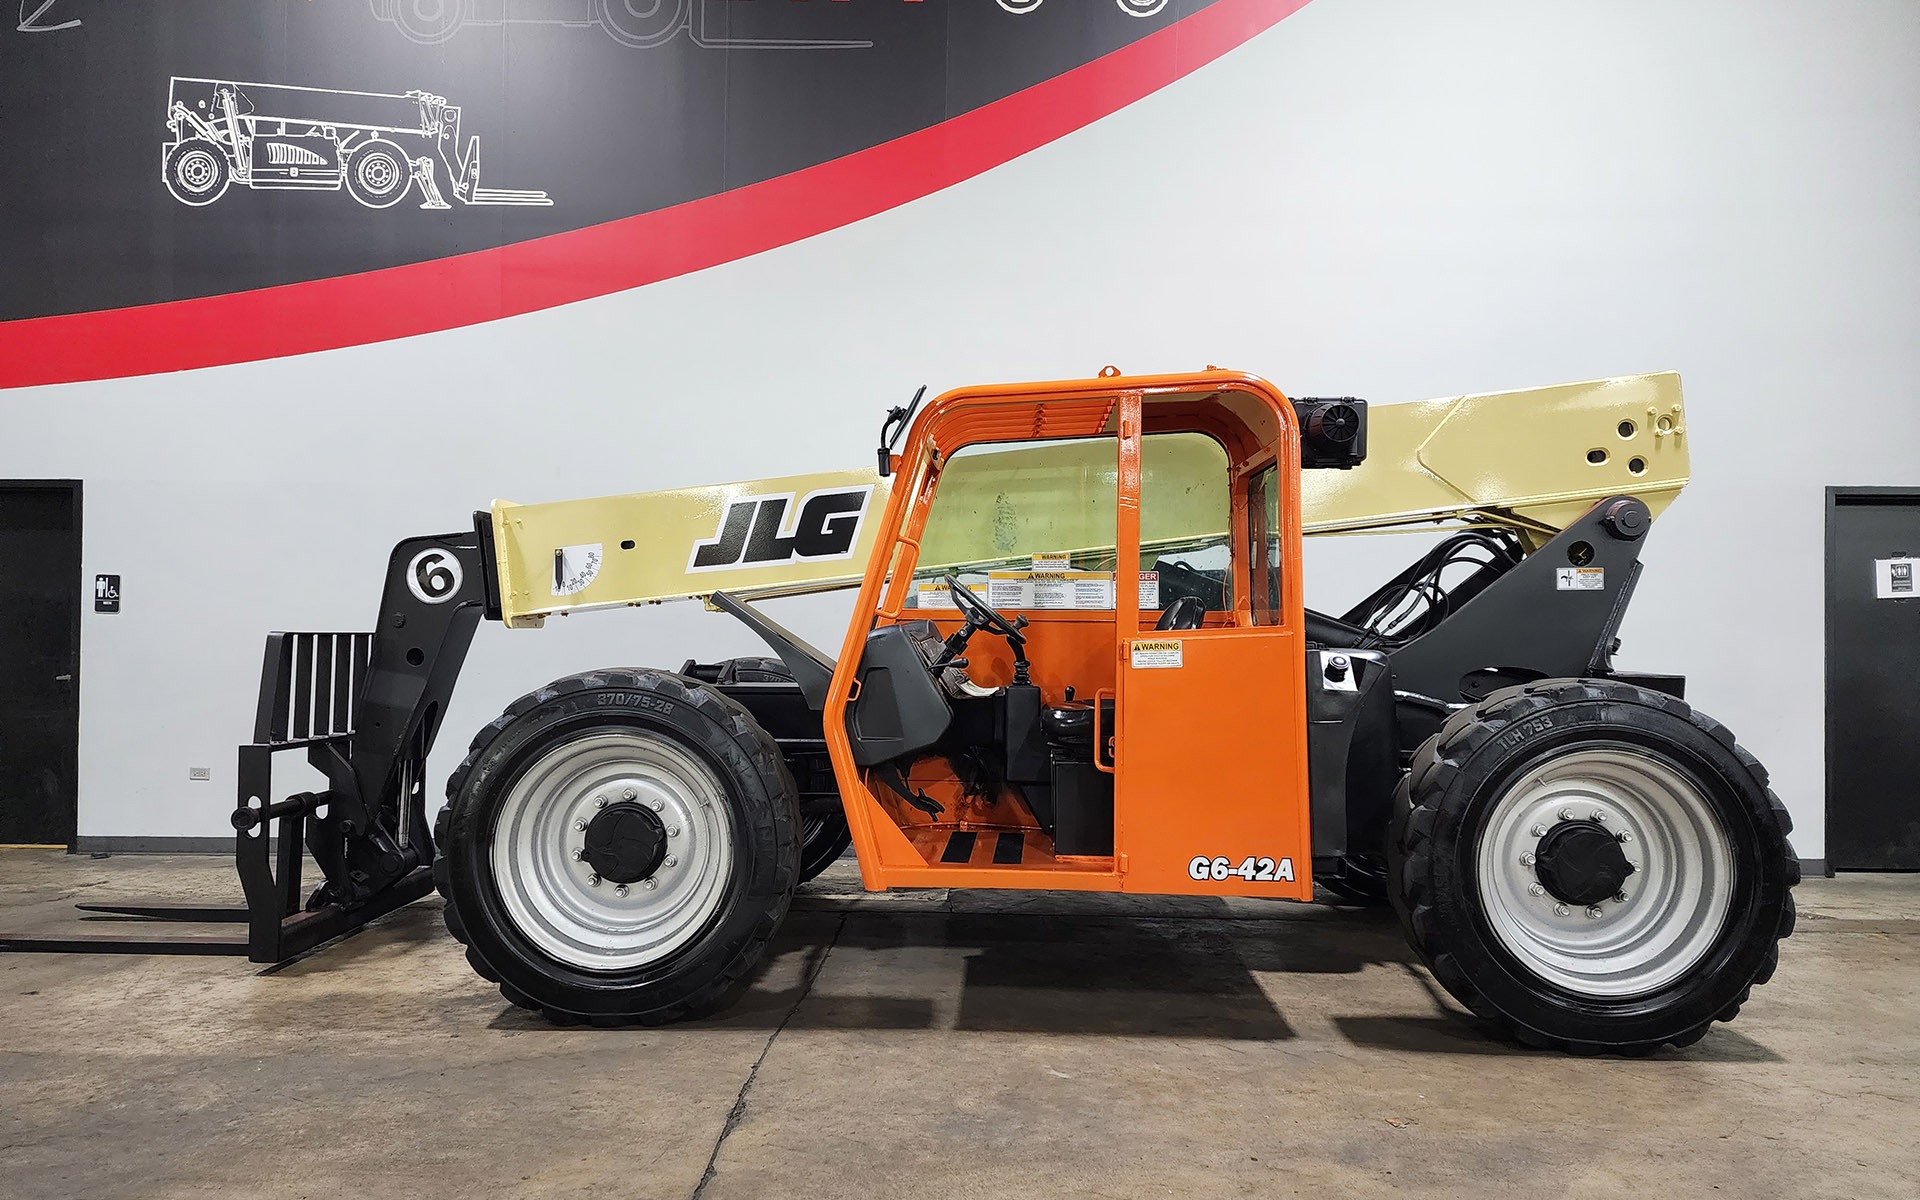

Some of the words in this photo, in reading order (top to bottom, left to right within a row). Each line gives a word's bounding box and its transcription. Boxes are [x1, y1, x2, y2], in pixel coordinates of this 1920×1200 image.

[692, 490, 868, 568] JLG
[416, 553, 455, 598] 6
[1141, 642, 1180, 651] WARNING
[597, 693, 675, 715] 370/75-28
[1496, 728, 1525, 750] TLH
[1188, 855, 1296, 882] G6-42A
